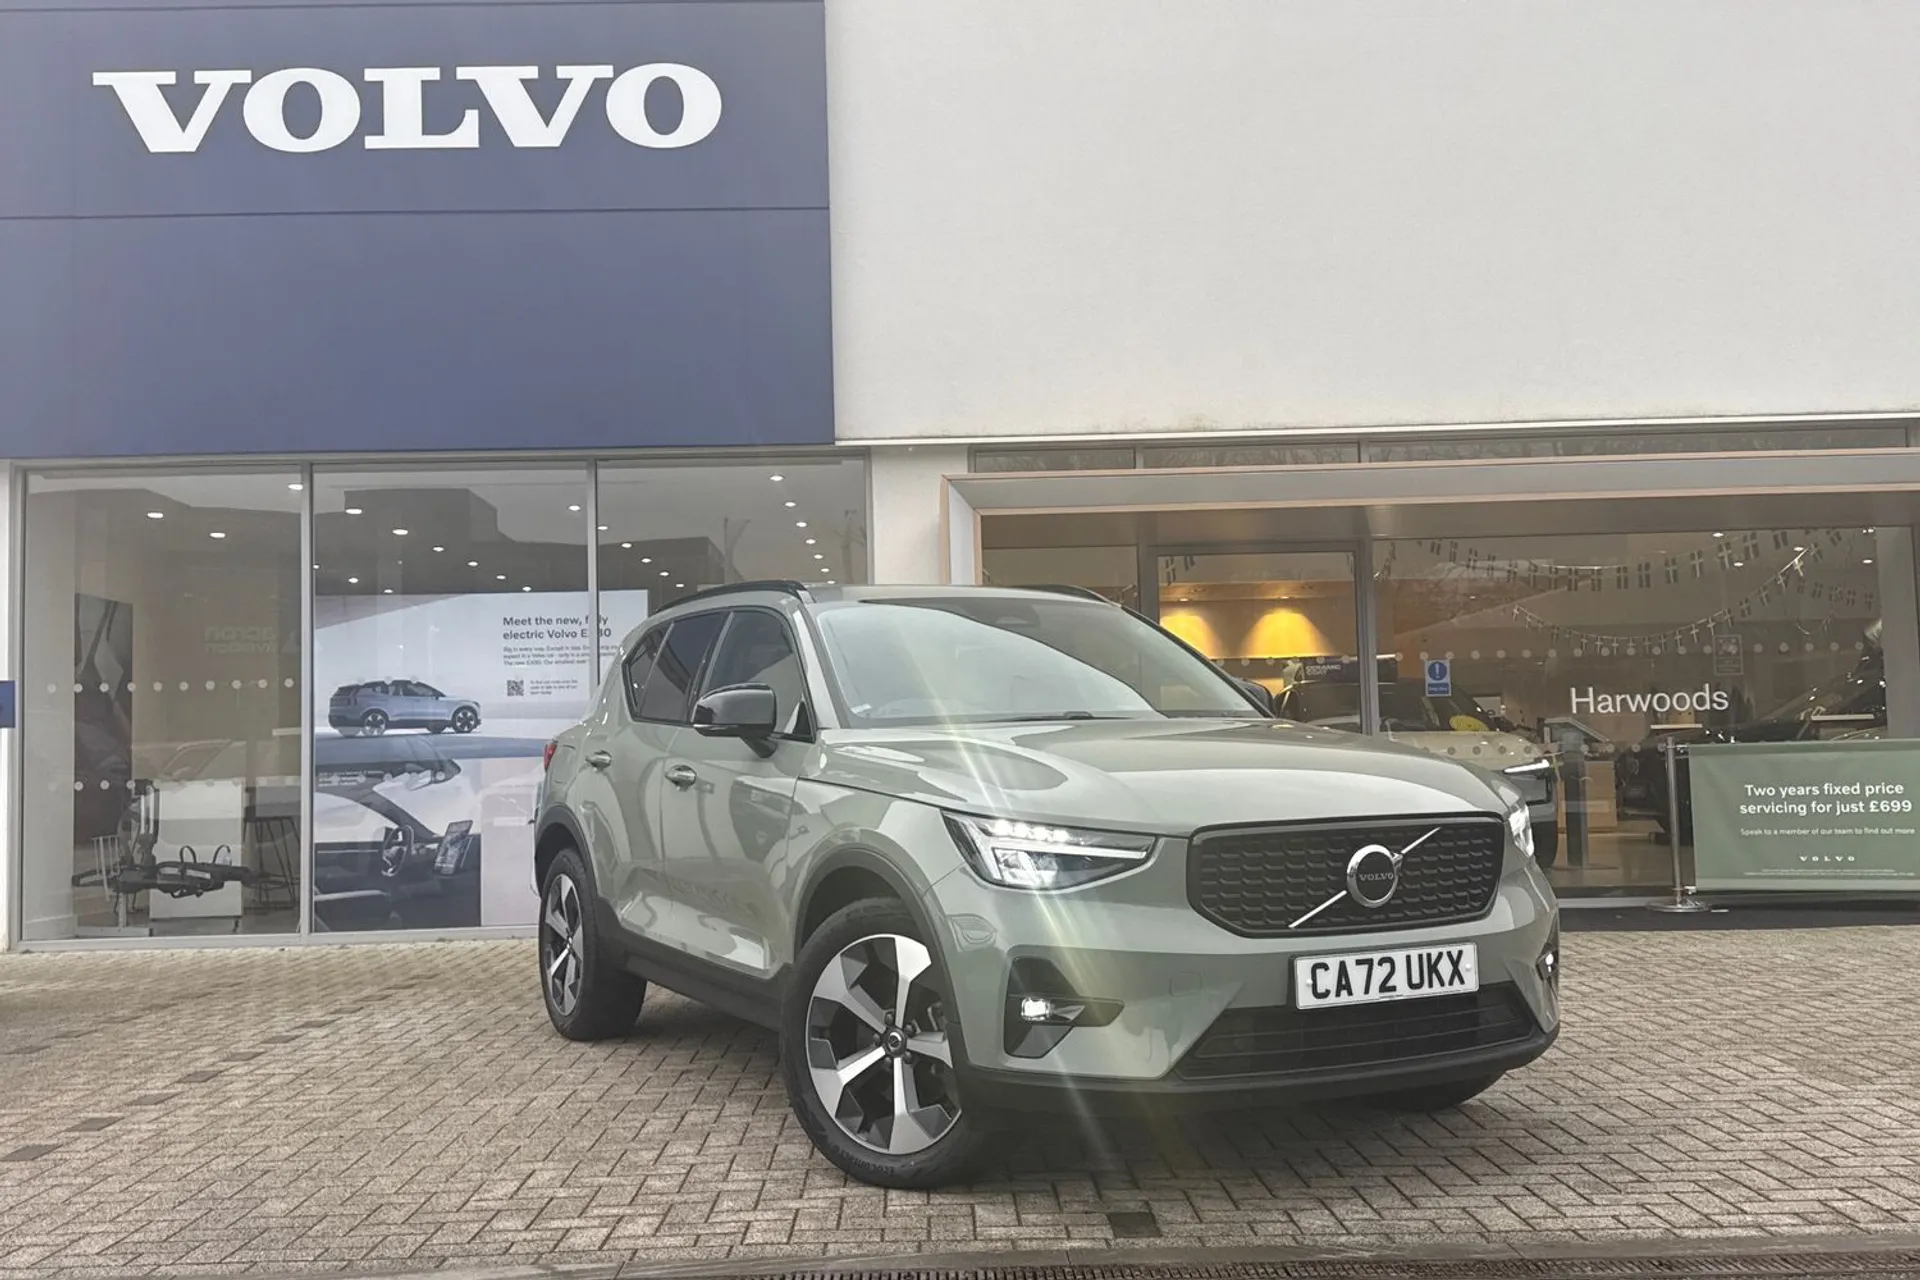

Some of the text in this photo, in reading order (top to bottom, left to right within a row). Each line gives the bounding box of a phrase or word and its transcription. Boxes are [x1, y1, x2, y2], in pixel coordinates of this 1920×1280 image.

[93, 63, 722, 153] VOLVO
[503, 616, 532, 626] Meet
[535, 616, 553, 625] the
[556, 617, 583, 627] new,
[503, 630, 544, 640] electric
[547, 629, 578, 639] Volvo
[1570, 683, 1729, 714] Harwoods
[1744, 781, 1905, 799] Two years fixed price
[1739, 799, 1913, 816] servicing for just £699
[1740, 828, 1763, 837] Speak
[1764, 828, 1772, 836] to
[1779, 827, 1810, 836] member
[1811, 827, 1819, 835] of
[1854, 827, 1863, 835] to
[1864, 826, 1880, 835] find
[1880, 827, 1894, 835] out
[1799, 855, 1856, 863] VOLVO
[1359, 872, 1394, 881] VOLVO
[1310, 949, 1466, 999] CA72 UKX
